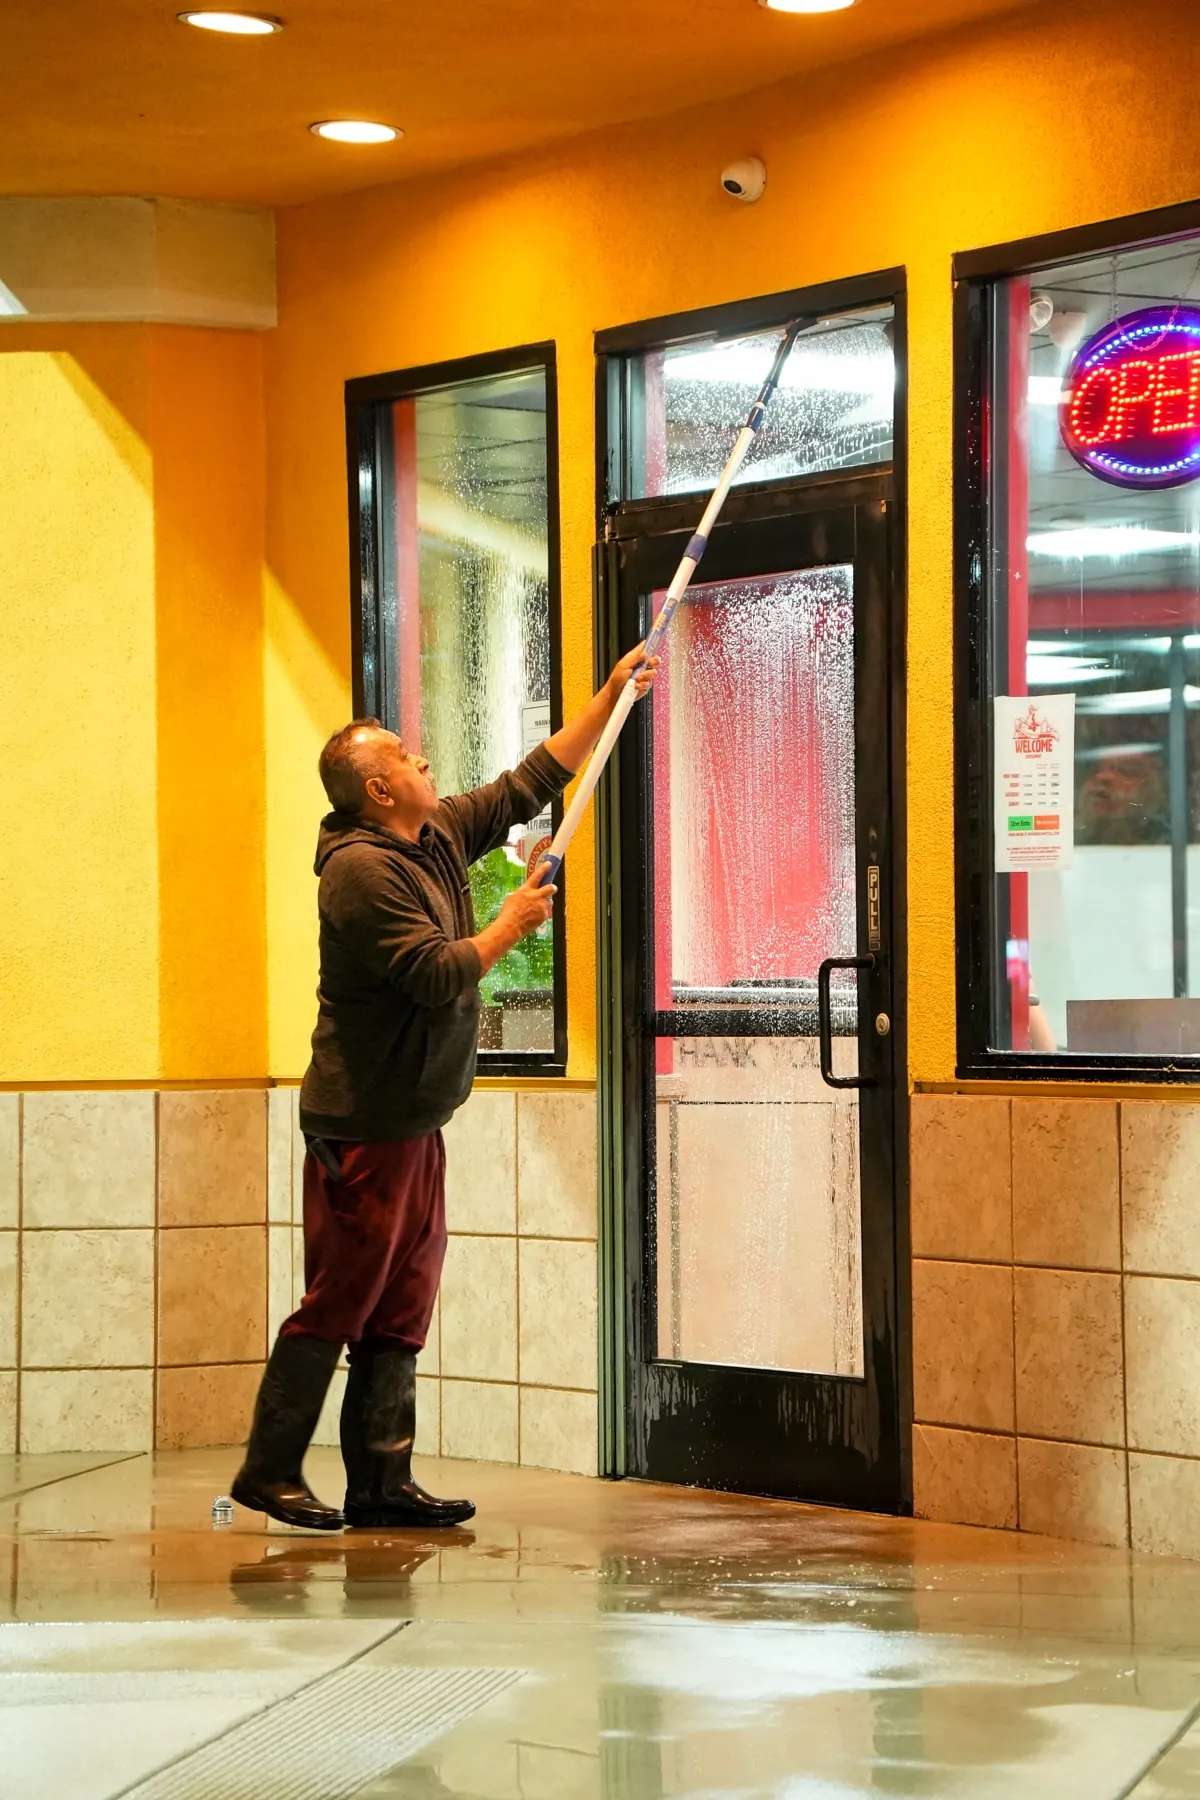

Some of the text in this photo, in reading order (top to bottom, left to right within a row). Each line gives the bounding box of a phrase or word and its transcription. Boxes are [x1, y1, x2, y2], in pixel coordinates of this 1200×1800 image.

[1071, 350, 1200, 445] OPE
[1015, 739, 1053, 753] WELCOME
[869, 873, 878, 930] PULL
